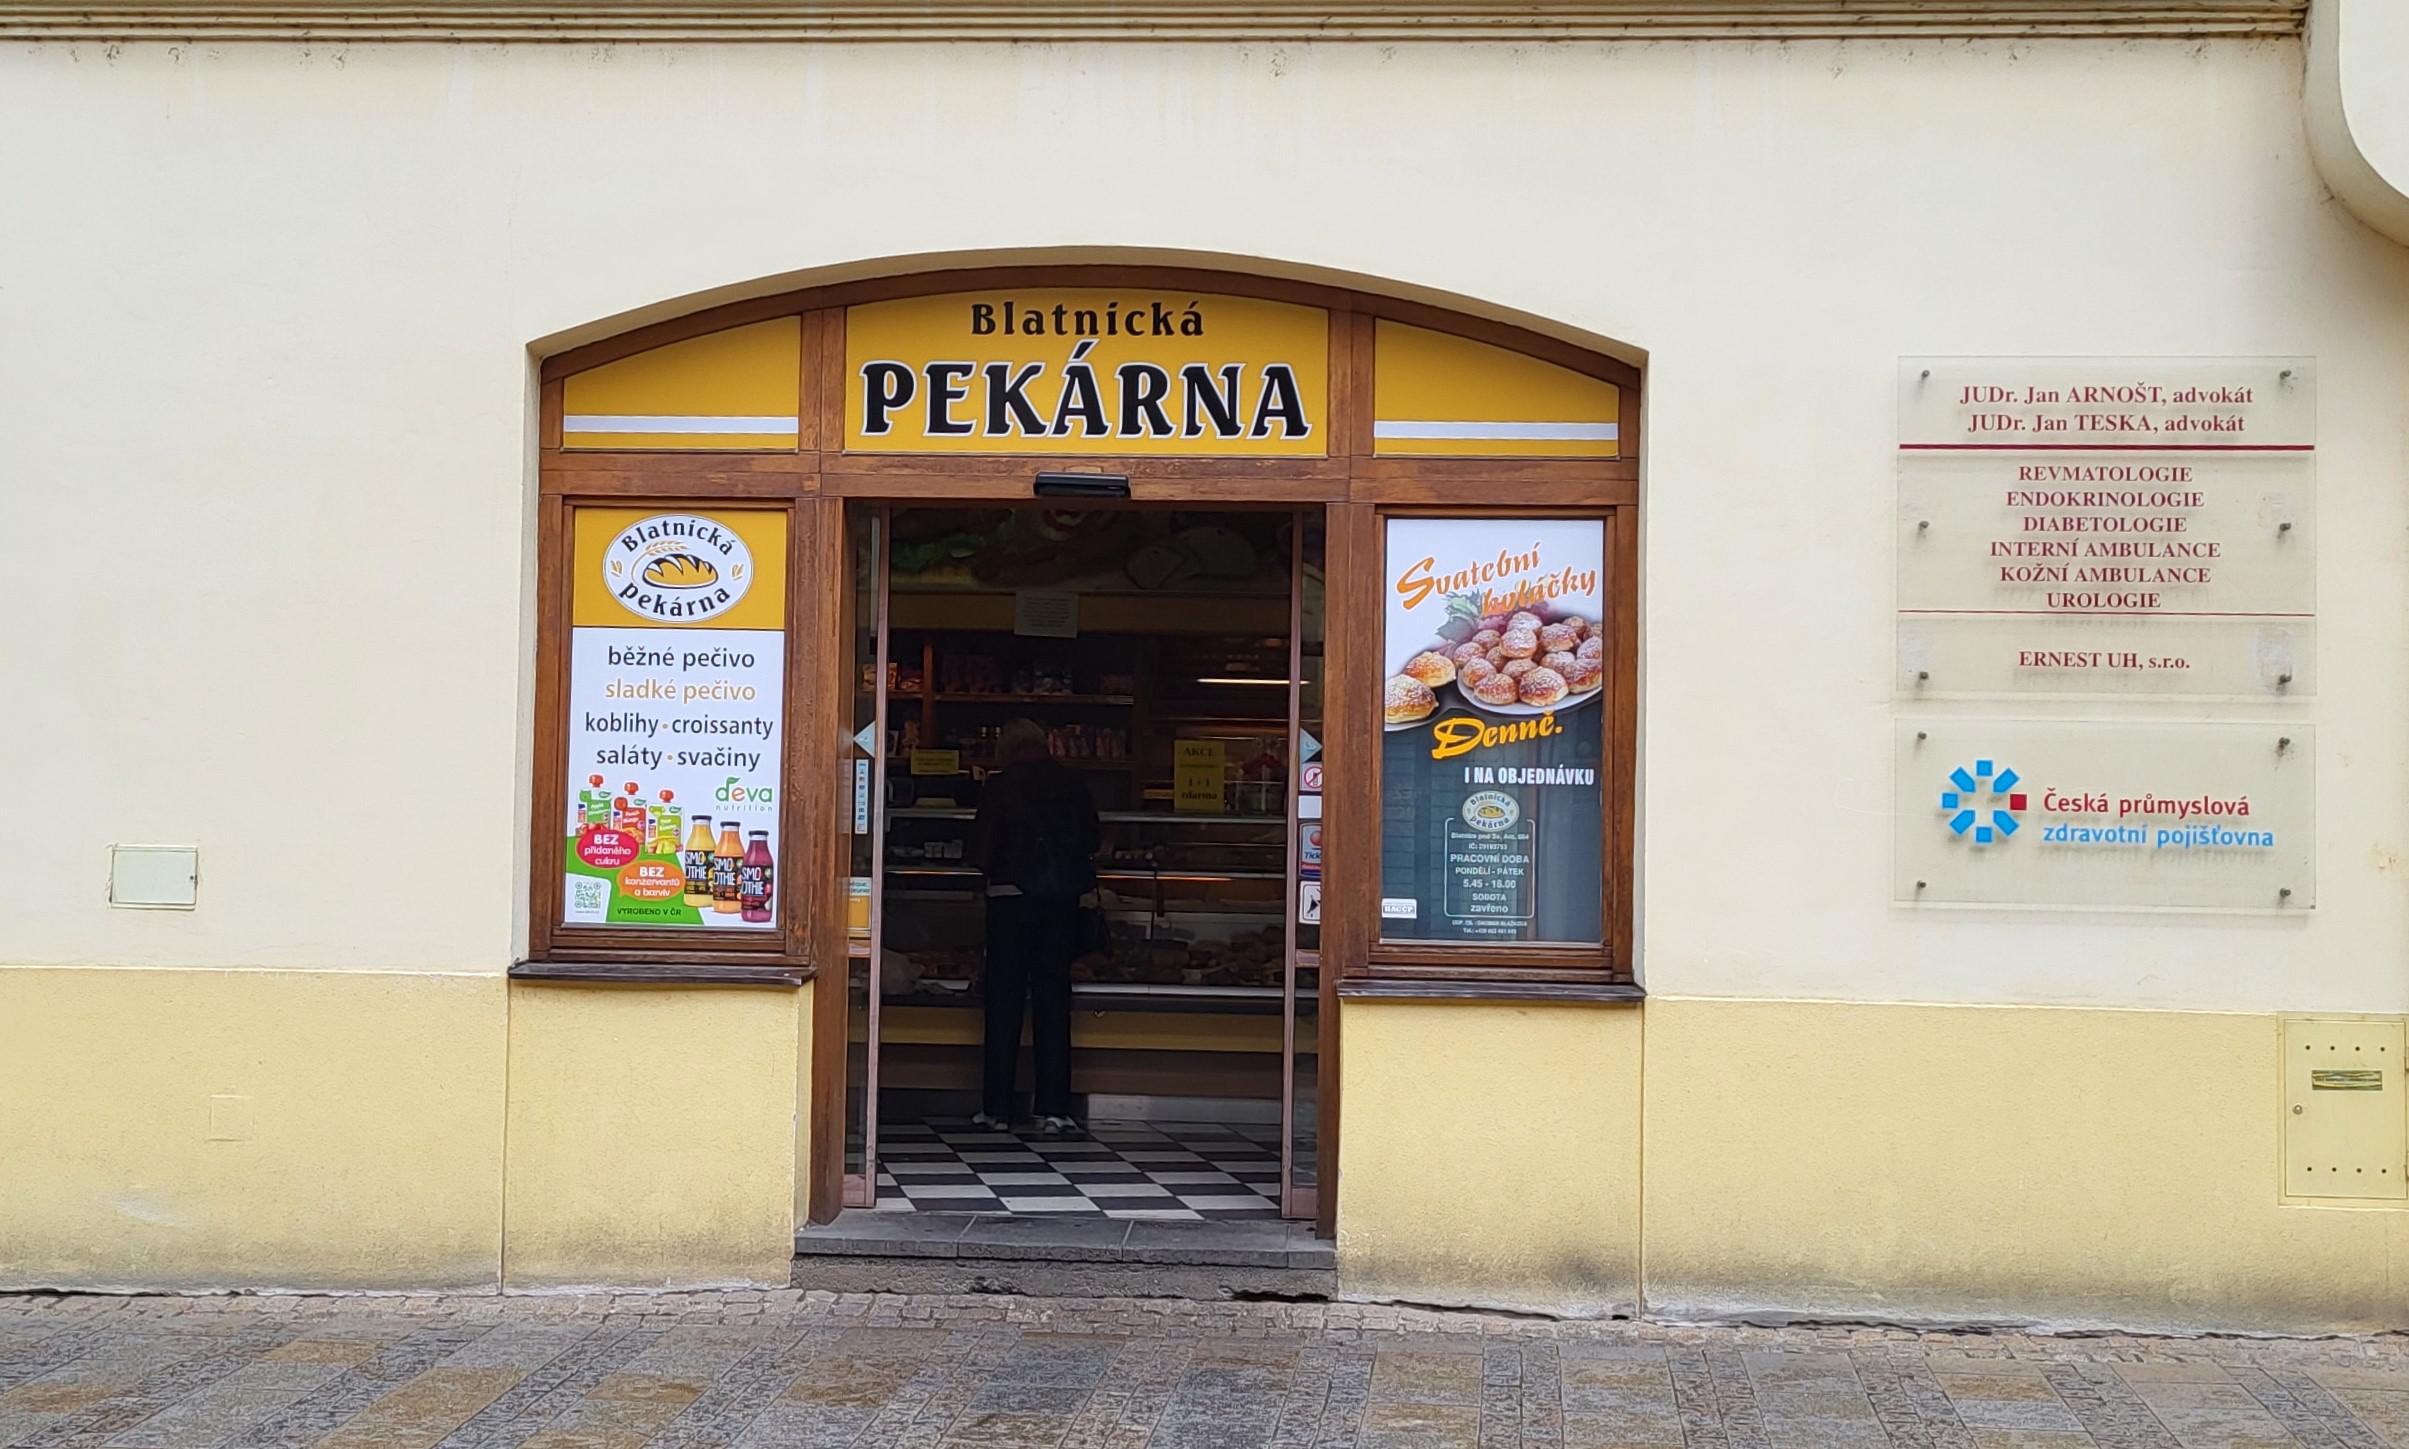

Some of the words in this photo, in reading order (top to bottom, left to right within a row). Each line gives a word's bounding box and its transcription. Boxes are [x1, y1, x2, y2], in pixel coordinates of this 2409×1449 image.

[971, 301, 1204, 336] Blatnická
[859, 338, 1313, 440] PEKÁRNA
[1960, 386, 2018, 404] JUDr.
[2024, 386, 2060, 404] Jan
[2066, 382, 2168, 406] ARNOŠT,
[2172, 385, 2254, 403] advokát
[1968, 414, 2026, 432] JUDr.
[2032, 414, 2068, 432] Jan
[2074, 414, 2159, 433] TESKA,
[2164, 414, 2245, 432] advokát
[2019, 466, 2193, 482] REVMATOLOGIE
[2006, 491, 2205, 507] ENDOKRINOLOGIE
[2024, 516, 2188, 532] DIABETOLOGIE
[621, 519, 735, 556] Blatnická
[1990, 538, 2079, 557] INTERNÍ
[2084, 542, 2221, 558] AMBULANCE
[1396, 541, 1541, 610] Svatební
[2000, 562, 2070, 582] KOŽNÍ
[2074, 567, 2212, 583] AMBULANCE
[619, 582, 731, 617] pekárna
[1481, 565, 1597, 617] koláčky
[2047, 592, 2161, 608] UROLOGIE
[608, 645, 675, 667] běžné
[682, 646, 755, 672] pečivo
[2019, 651, 2102, 667] ERNEST
[2108, 652, 2144, 671] UH,
[2148, 656, 2190, 669] s.r.o.
[605, 678, 677, 698] sladké
[683, 679, 756, 704] pečivo
[585, 711, 659, 738] koblihy
[672, 714, 774, 740] croissanty
[1431, 710, 1563, 760] Denně.
[596, 744, 663, 771] saláty
[677, 746, 761, 772] svačiny
[1464, 767, 1471, 784] I
[1474, 767, 1494, 784] NA
[1498, 764, 1595, 785] OBJEDNÁVKU
[715, 777, 773, 802] deva
[2043, 787, 2109, 813] Česká
[2119, 793, 2250, 820] průmyslová
[594, 834, 619, 845] BEZ
[2043, 823, 2148, 844] zdravotní
[2157, 823, 2274, 848] pojišťovna
[1450, 852, 1500, 863] PRACOVNÍ
[1502, 854, 1530, 864] DOBA
[639, 867, 665, 877] BEZ
[1497, 866, 1525, 876] PÁTEK
